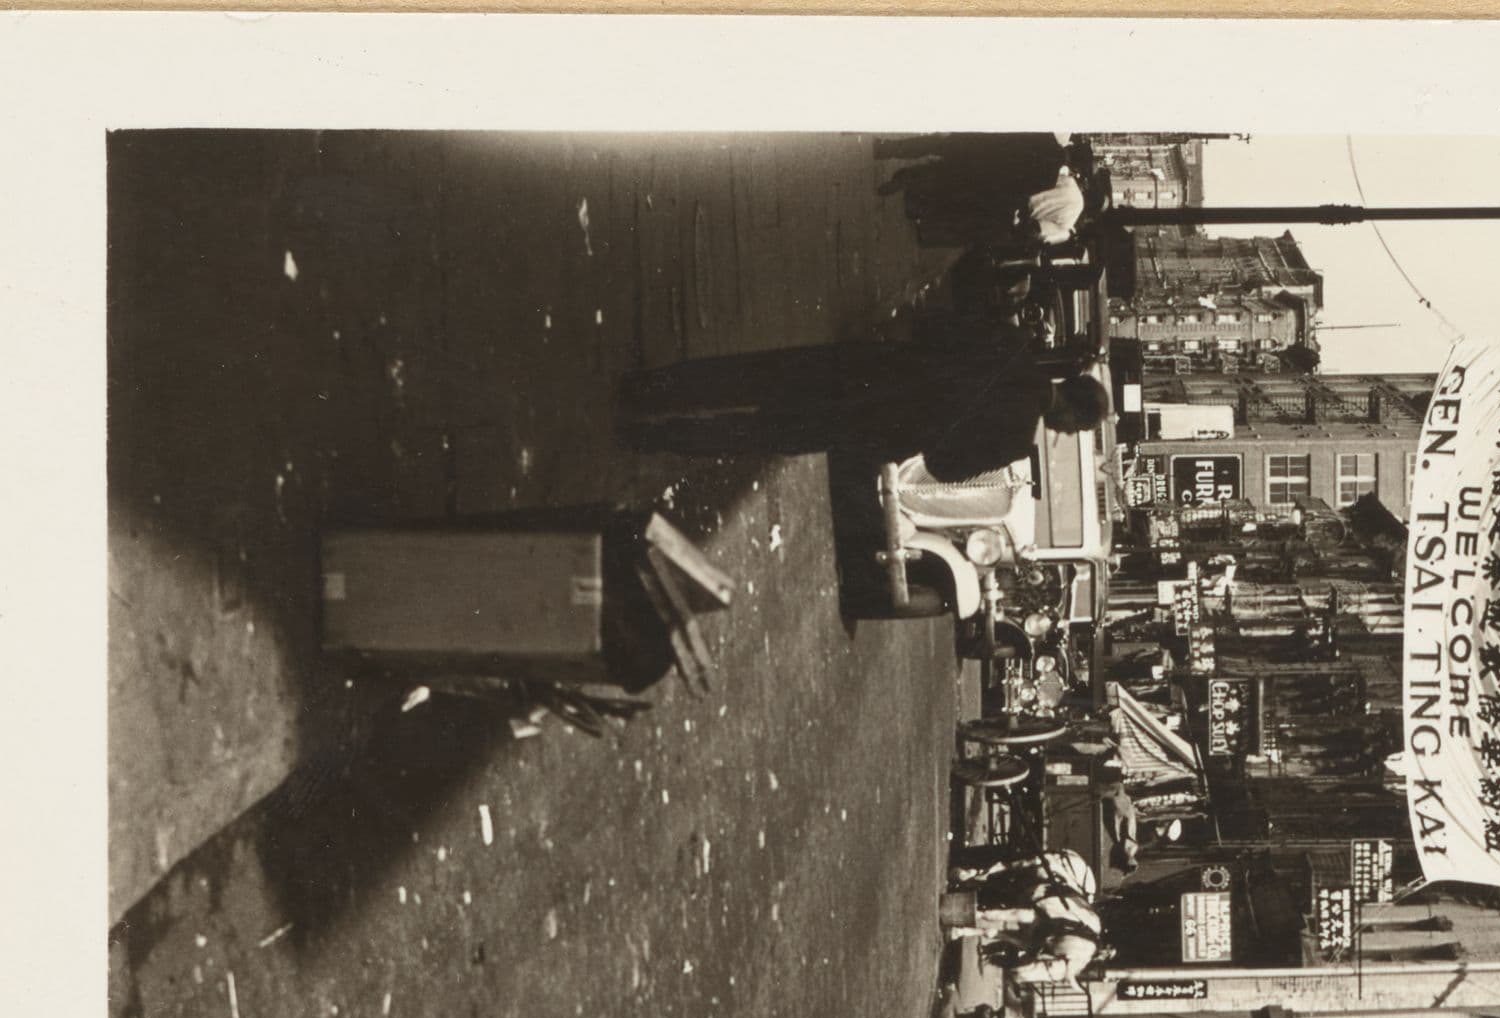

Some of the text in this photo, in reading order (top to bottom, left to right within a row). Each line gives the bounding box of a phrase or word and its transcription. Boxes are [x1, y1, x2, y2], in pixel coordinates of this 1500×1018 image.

[1211, 682, 1230, 753] CHOP SUEY
[1410, 365, 1466, 855] GEN. TSAI TING KAI
[1448, 486, 1484, 738] WELCOME
